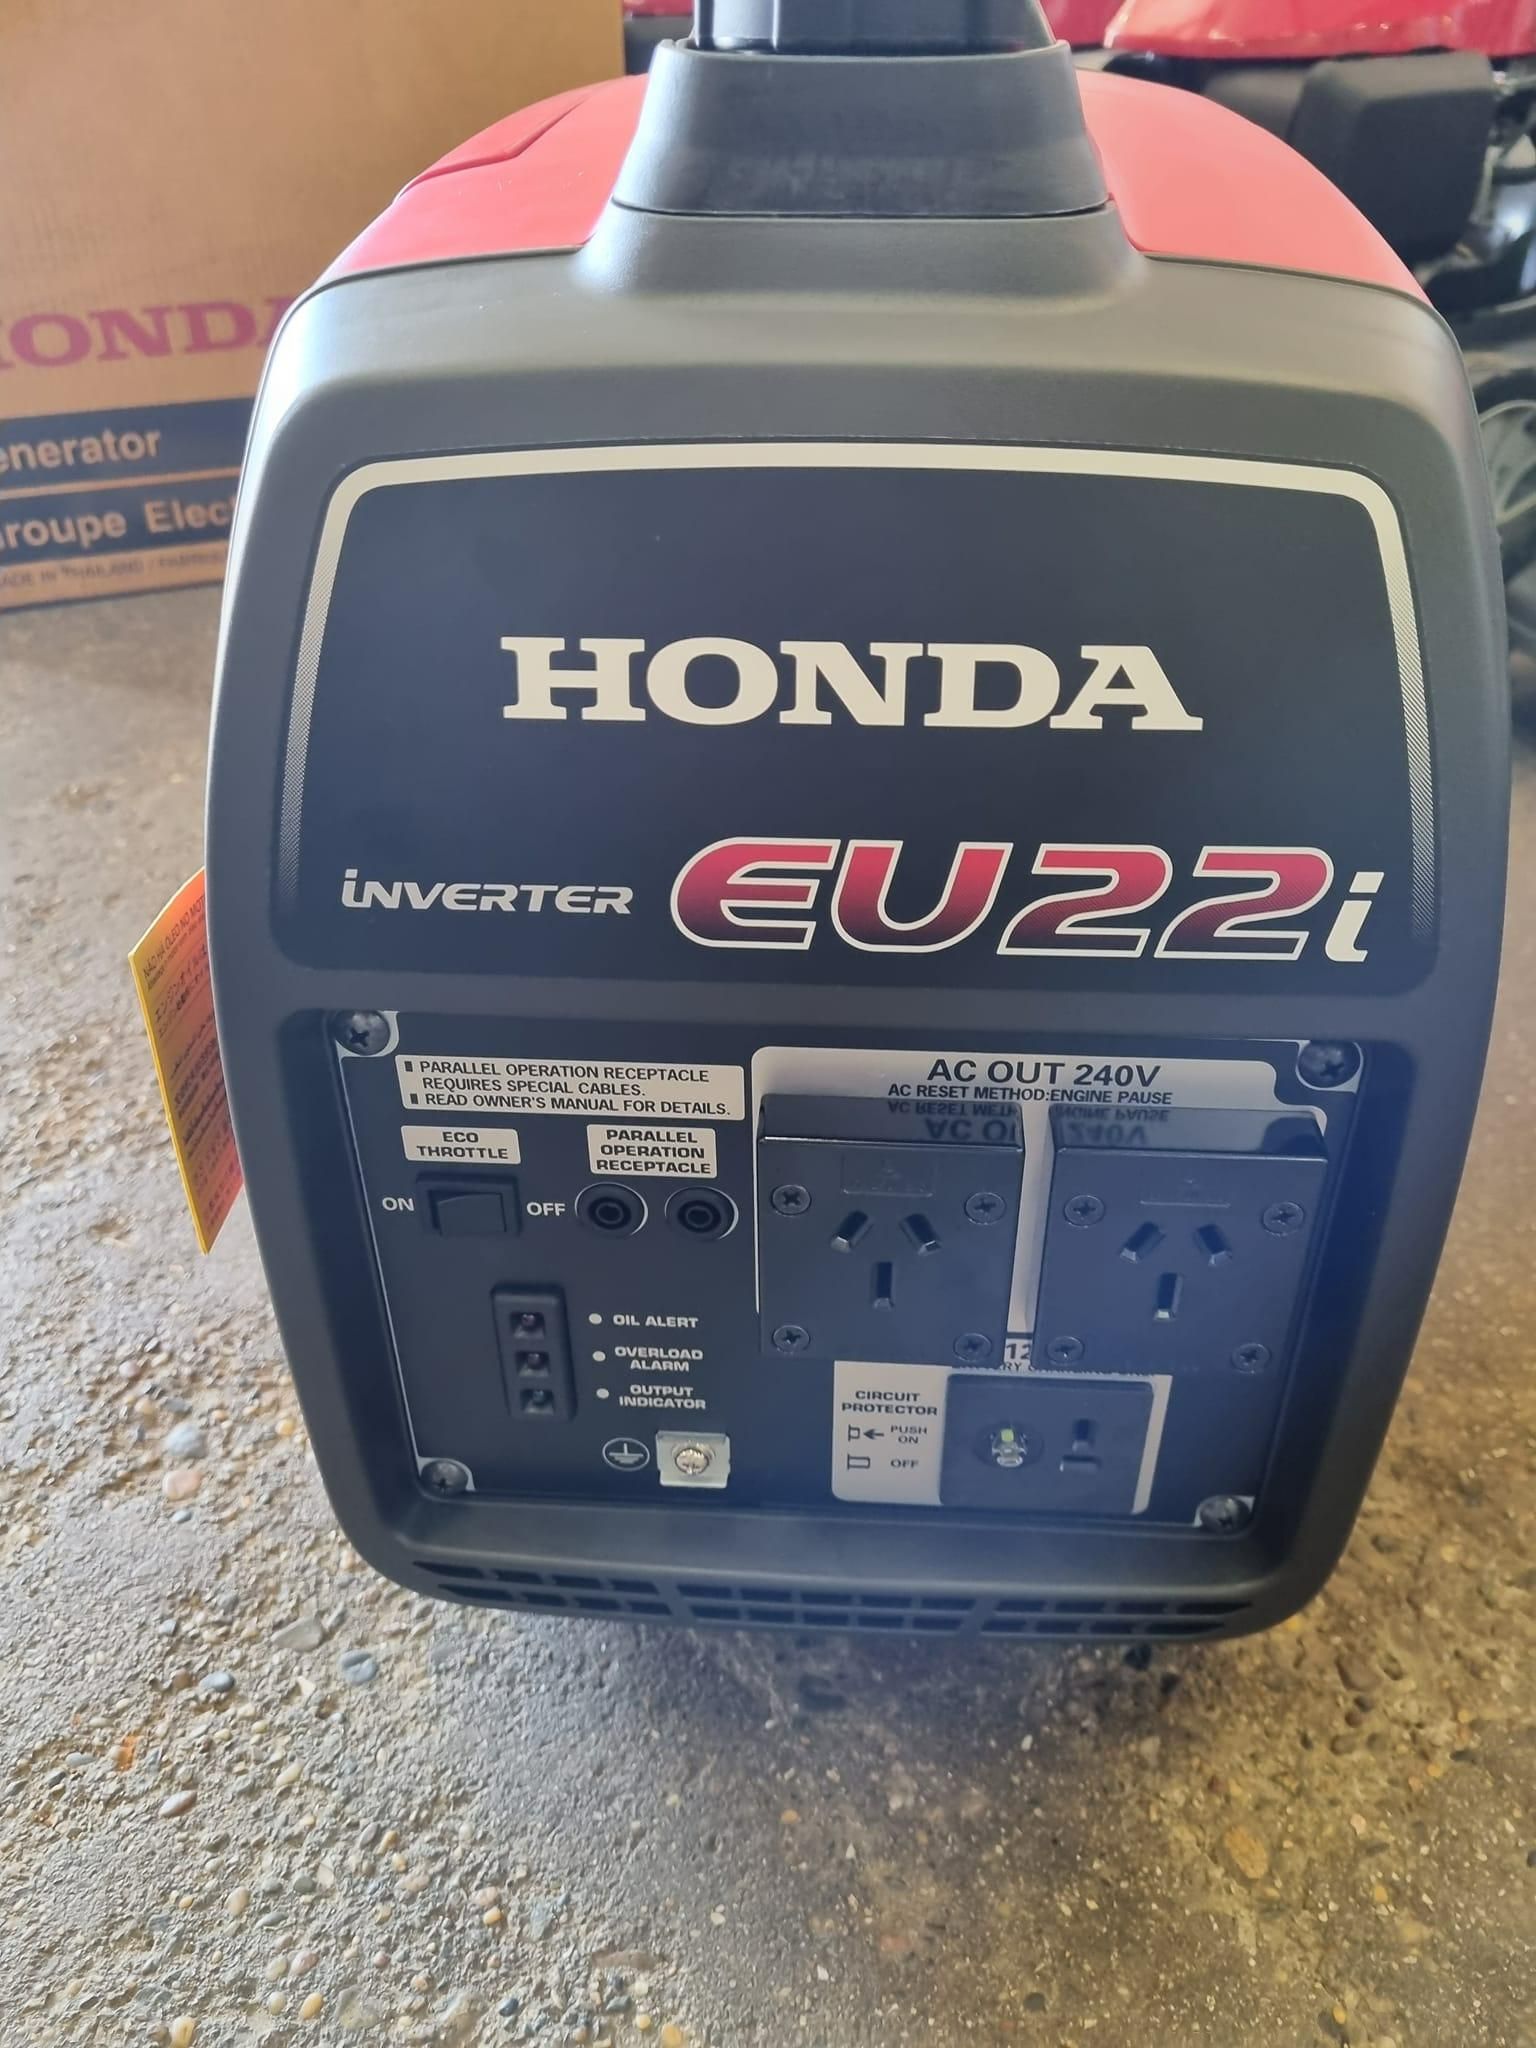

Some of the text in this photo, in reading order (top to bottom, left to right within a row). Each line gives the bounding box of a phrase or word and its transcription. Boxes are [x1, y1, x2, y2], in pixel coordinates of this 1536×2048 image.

[0, 296, 294, 371] OND
[0, 509, 127, 549] roupe
[501, 636, 1204, 731] HONDA
[669, 835, 1385, 963] EU22i
[419, 1060, 710, 1082] PARALLEL OPERATION RECEPTACLE
[927, 1058, 1161, 1088] AC OUT 240V
[422, 1077, 646, 1097] REQUIRES SPECIAL CABLES.
[888, 1083, 911, 1097] AC
[916, 1084, 970, 1099] RESET
[1117, 1091, 1173, 1105] PAUSE
[425, 1093, 731, 1116] READ OWNER'S MANUAL FOR DETAILS.
[442, 1131, 479, 1143] ECO
[606, 1129, 698, 1143] PARALLEL
[416, 1145, 508, 1160] THROTTLE
[600, 1144, 705, 1159] OPERATION
[596, 1159, 711, 1174] RECEPTACLE
[382, 1196, 415, 1212] ON
[526, 1202, 566, 1217] OFF
[613, 1314, 699, 1328] OIL ALERT
[614, 1346, 704, 1360] OVERLOAD
[630, 1359, 690, 1372] ALARM
[630, 1384, 694, 1397] OUTPUT
[855, 1390, 921, 1402] CIRCUIT
[619, 1396, 706, 1410] INDICATOR
[841, 1402, 938, 1416] PROTECTOR
[890, 1424, 928, 1434] PUSH
[898, 1435, 919, 1444] ON
[890, 1459, 919, 1469] OFF
